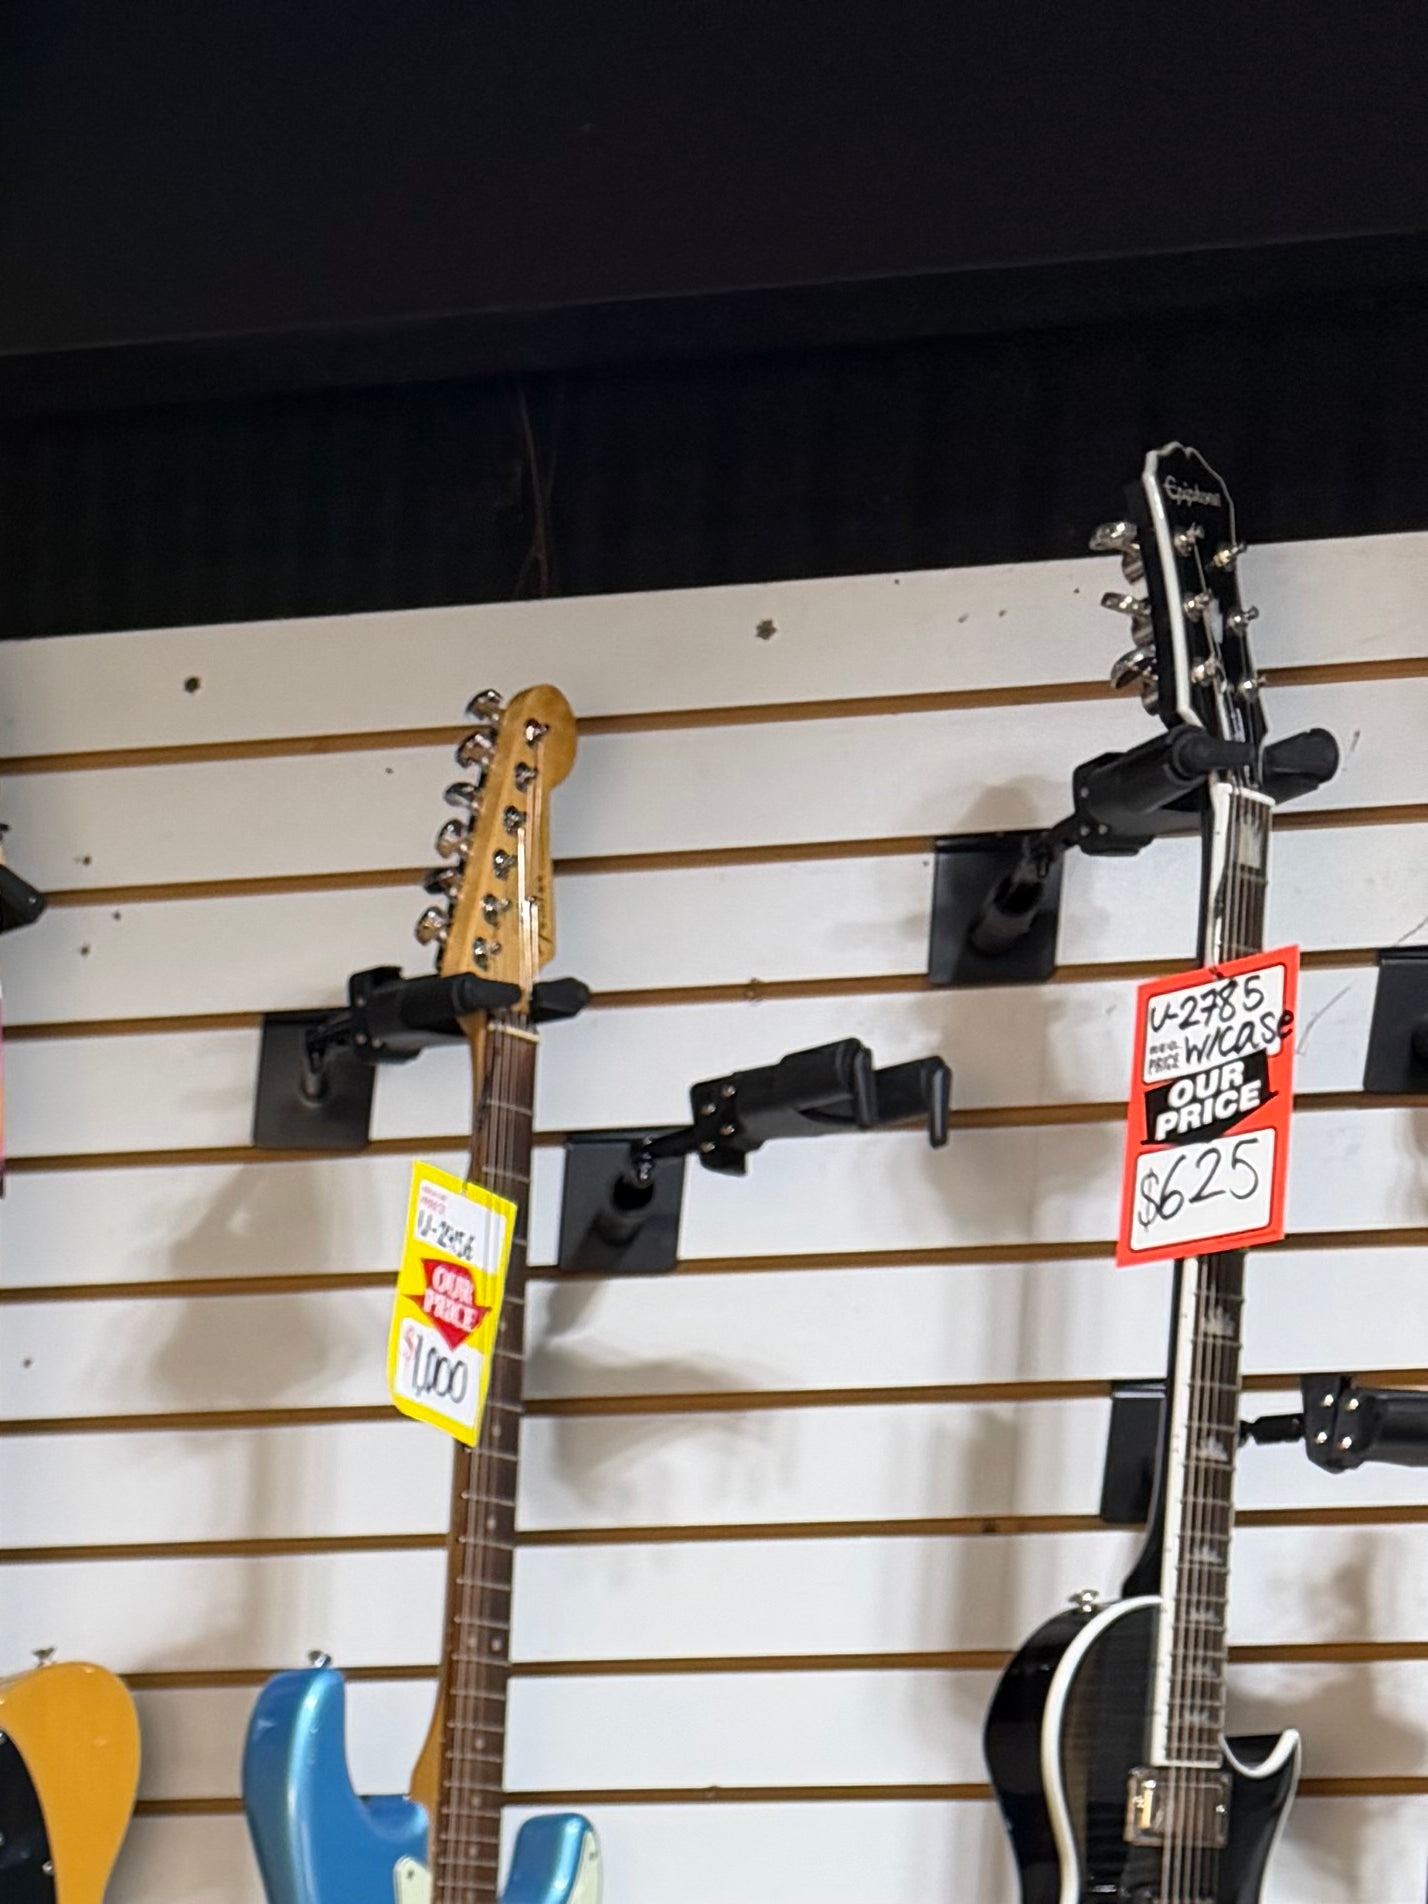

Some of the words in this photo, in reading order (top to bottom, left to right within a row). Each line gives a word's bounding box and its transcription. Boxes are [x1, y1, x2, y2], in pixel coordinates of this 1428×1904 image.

[1155, 1079, 1262, 1141] PRICE
[1168, 1060, 1244, 1108] OUR
[1138, 1138, 1259, 1231] $625
